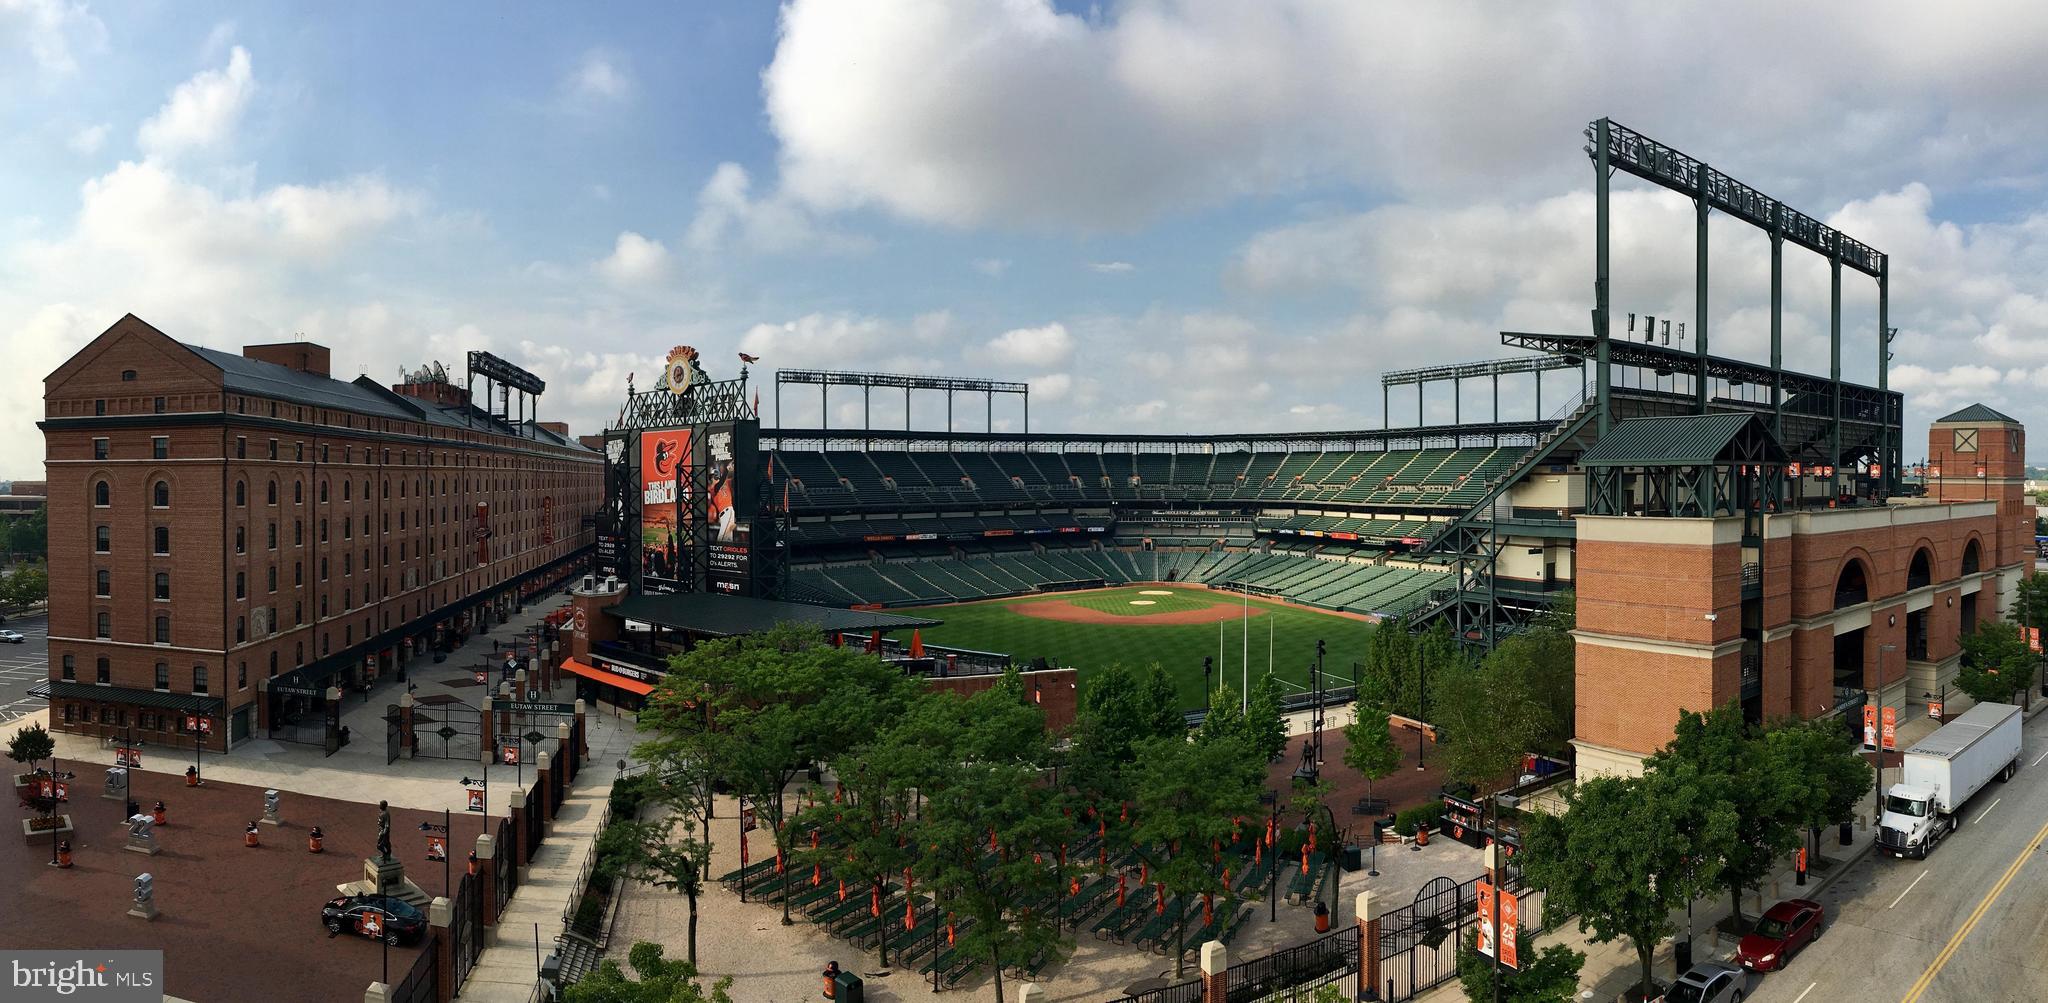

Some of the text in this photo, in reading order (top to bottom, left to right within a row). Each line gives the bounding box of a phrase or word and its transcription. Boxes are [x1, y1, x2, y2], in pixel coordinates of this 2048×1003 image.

[1884, 725, 1894, 734] 25
[128, 813, 155, 838] 22
[1502, 922, 1514, 939] 25
